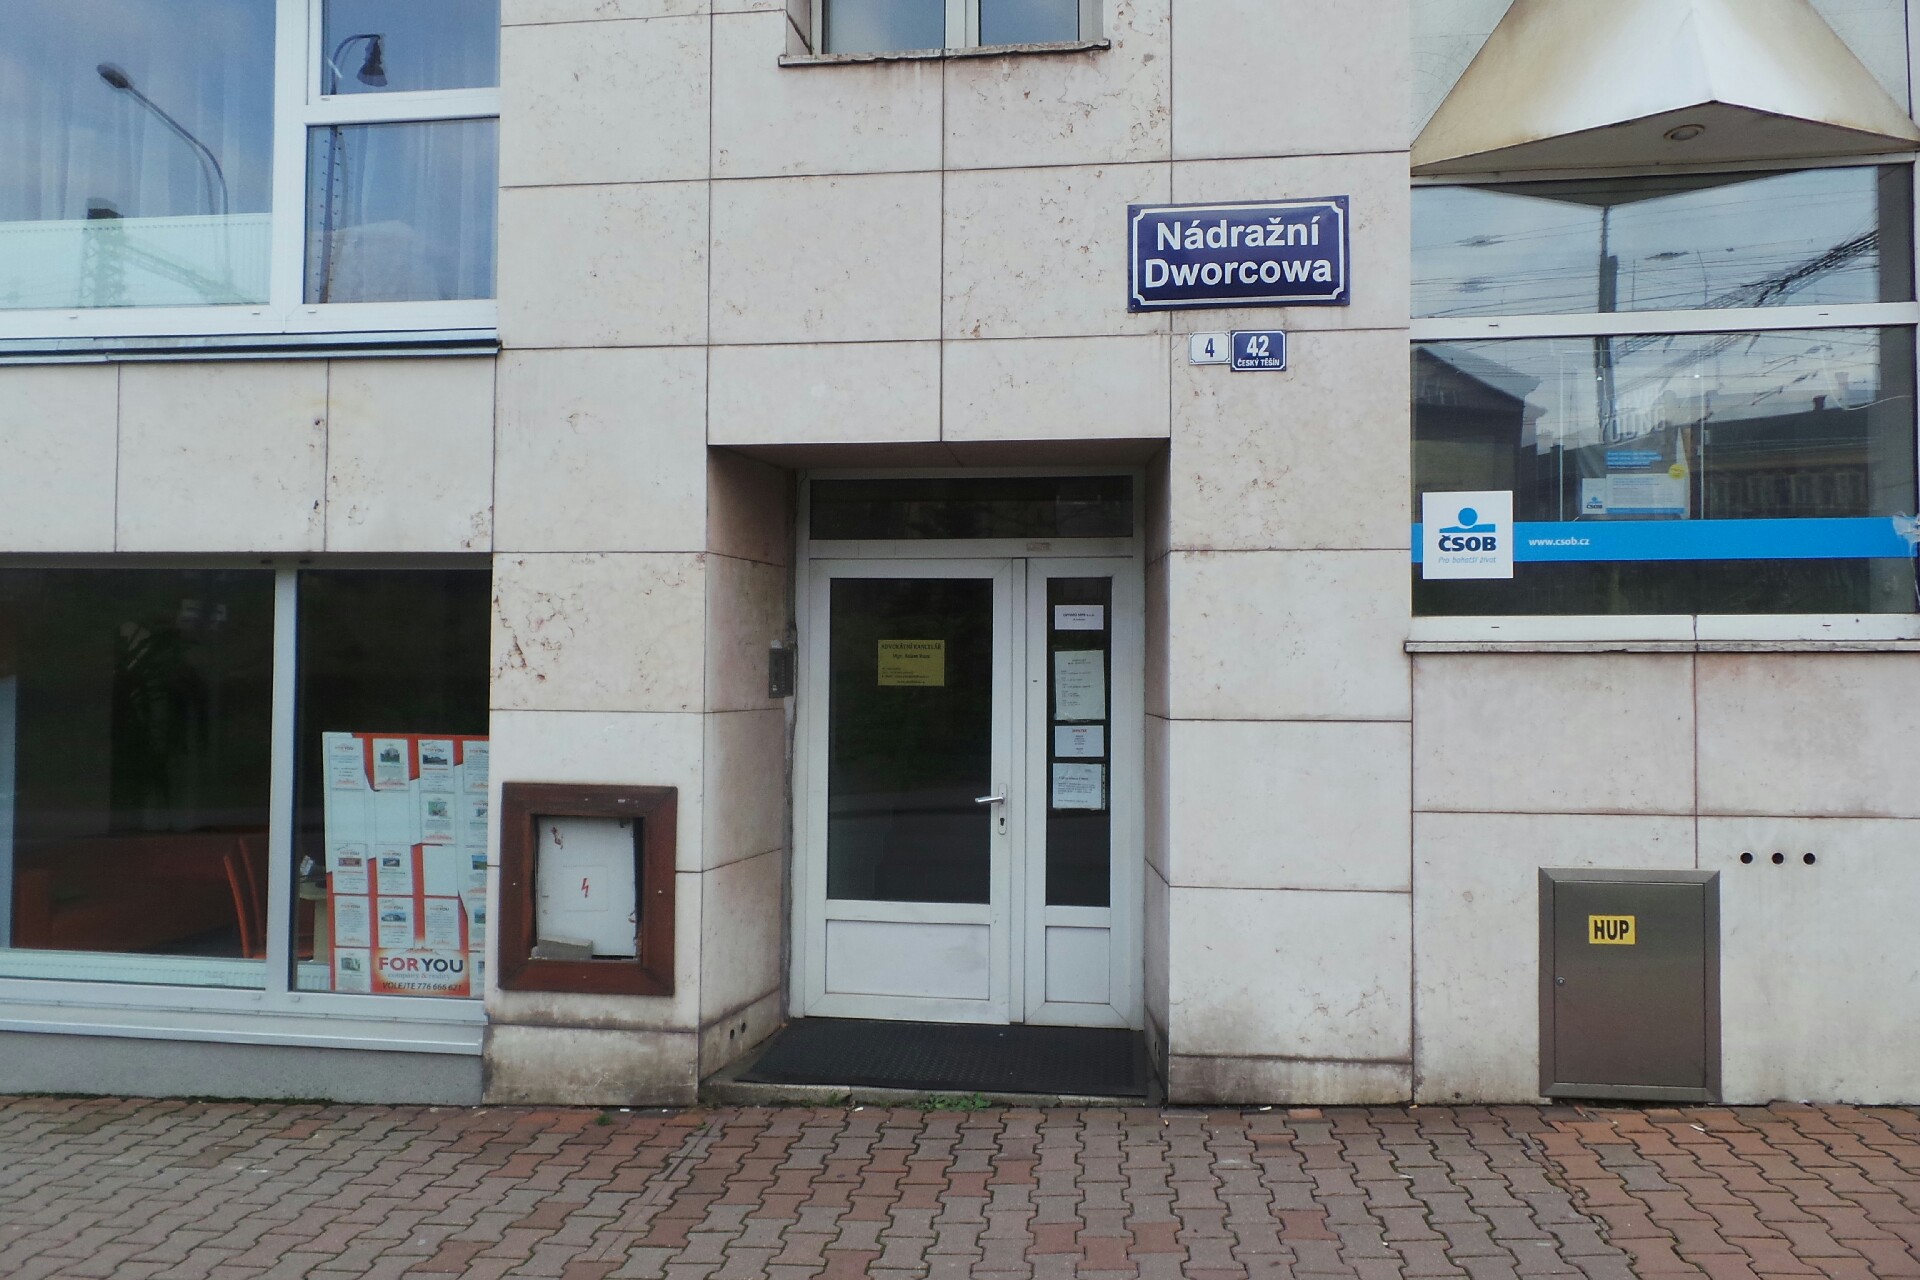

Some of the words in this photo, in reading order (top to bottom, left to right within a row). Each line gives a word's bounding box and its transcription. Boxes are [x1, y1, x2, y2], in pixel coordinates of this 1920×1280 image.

[1157, 215, 1321, 251] Nádražní
[1145, 257, 1332, 288] Dworcowa
[1204, 337, 1215, 358] 4
[1246, 335, 1270, 357] 42
[1237, 357, 1260, 367] ČESKÝ
[1260, 357, 1280, 366] TĚŠÍN
[1438, 535, 1497, 552] ČSOB
[1528, 536, 1591, 546] www.csob.cz
[1438, 556, 1450, 564] Pro
[1593, 919, 1630, 940] HUP
[378, 957, 419, 971] FOR
[421, 958, 464, 973] YOU
[382, 982, 416, 990] VOLEJTE
[417, 982, 431, 990] 776
